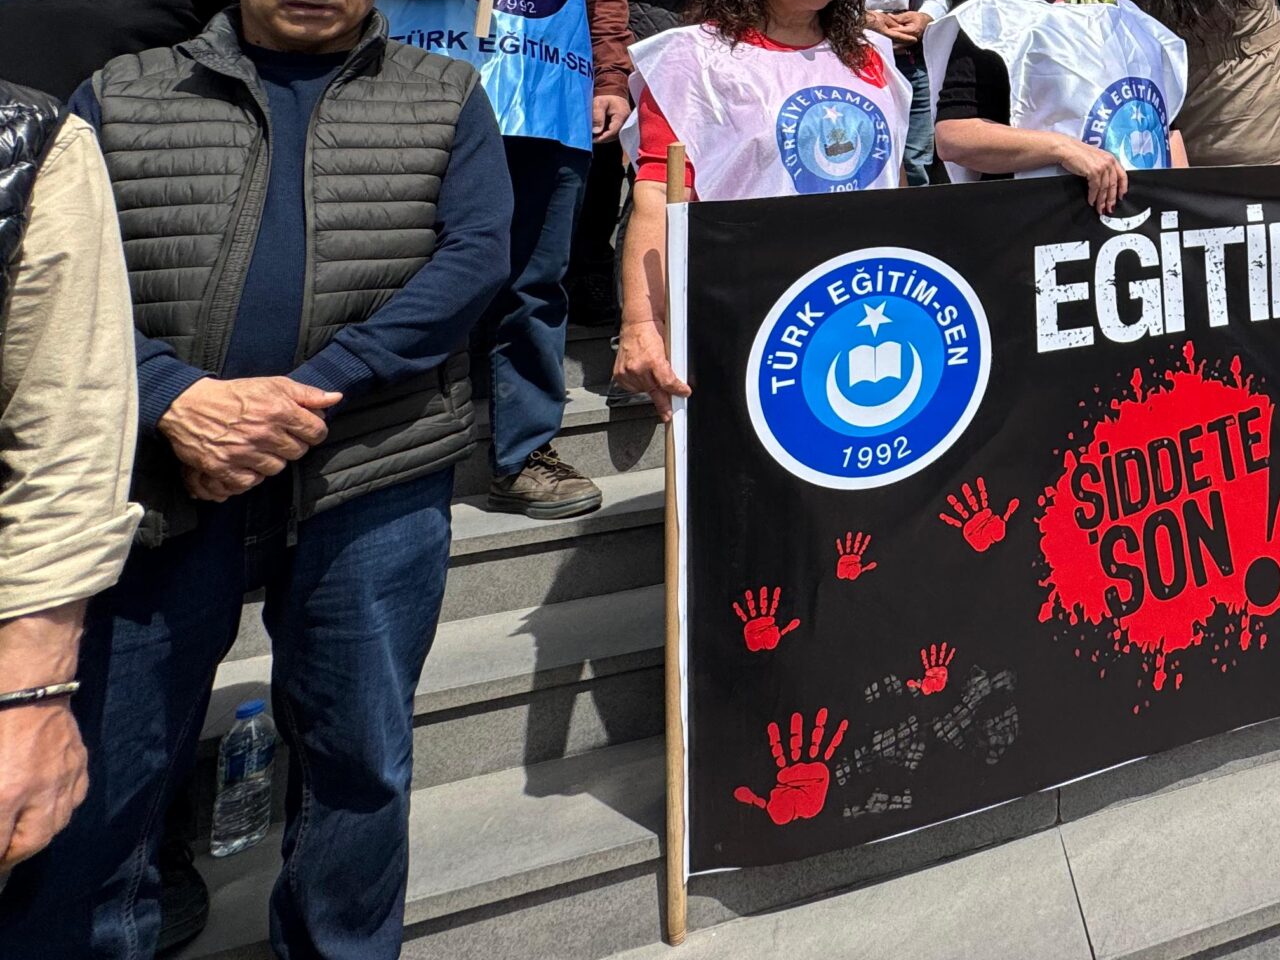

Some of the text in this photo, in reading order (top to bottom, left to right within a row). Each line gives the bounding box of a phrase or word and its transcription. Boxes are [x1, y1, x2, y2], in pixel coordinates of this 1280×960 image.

[814, 88, 889, 160] KAMU-SEN
[1083, 102, 1112, 148] ÜRK
[767, 264, 969, 395] TÜRK EĞİTİM-SEN
[842, 435, 912, 469] 1992
[1070, 406, 1270, 545] ŞİDDETE
